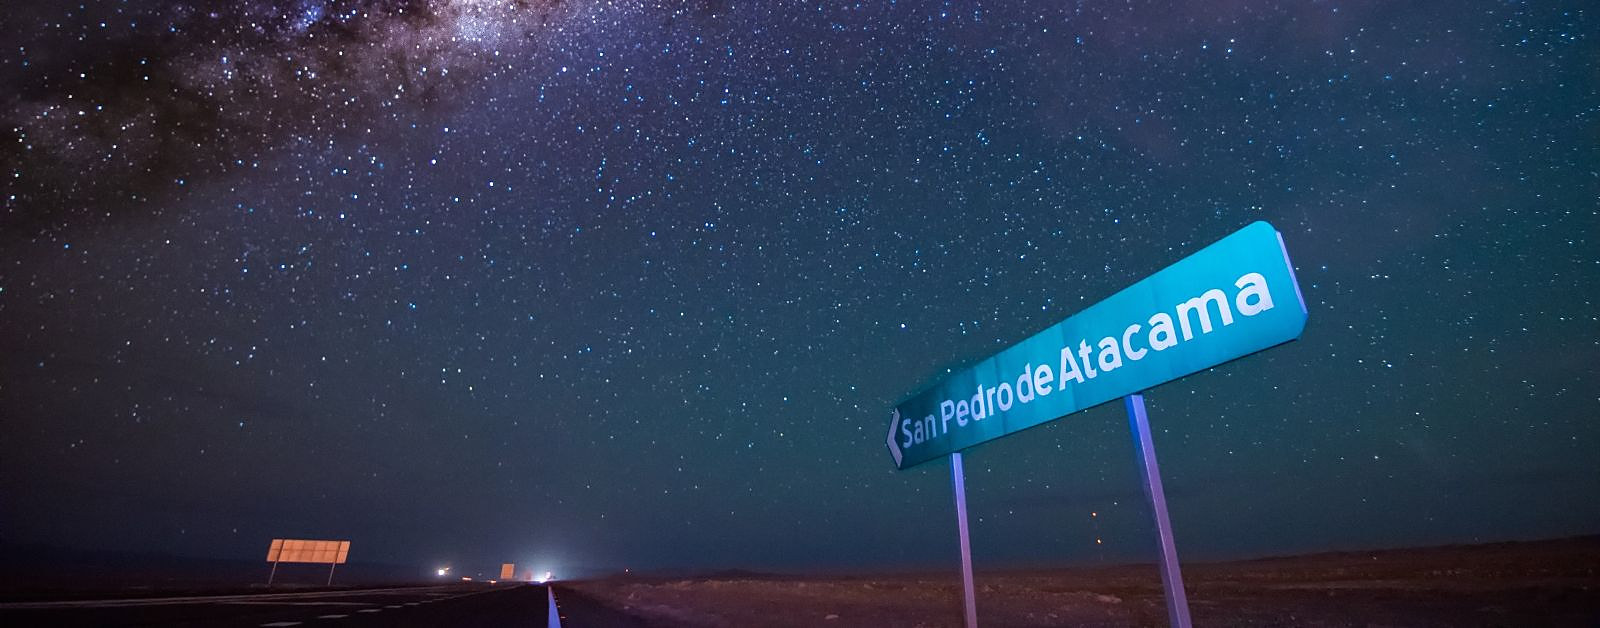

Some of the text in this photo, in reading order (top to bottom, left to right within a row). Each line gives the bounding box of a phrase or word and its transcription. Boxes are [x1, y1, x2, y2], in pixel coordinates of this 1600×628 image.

[902, 272, 1275, 448] San Pedro de Atacama
